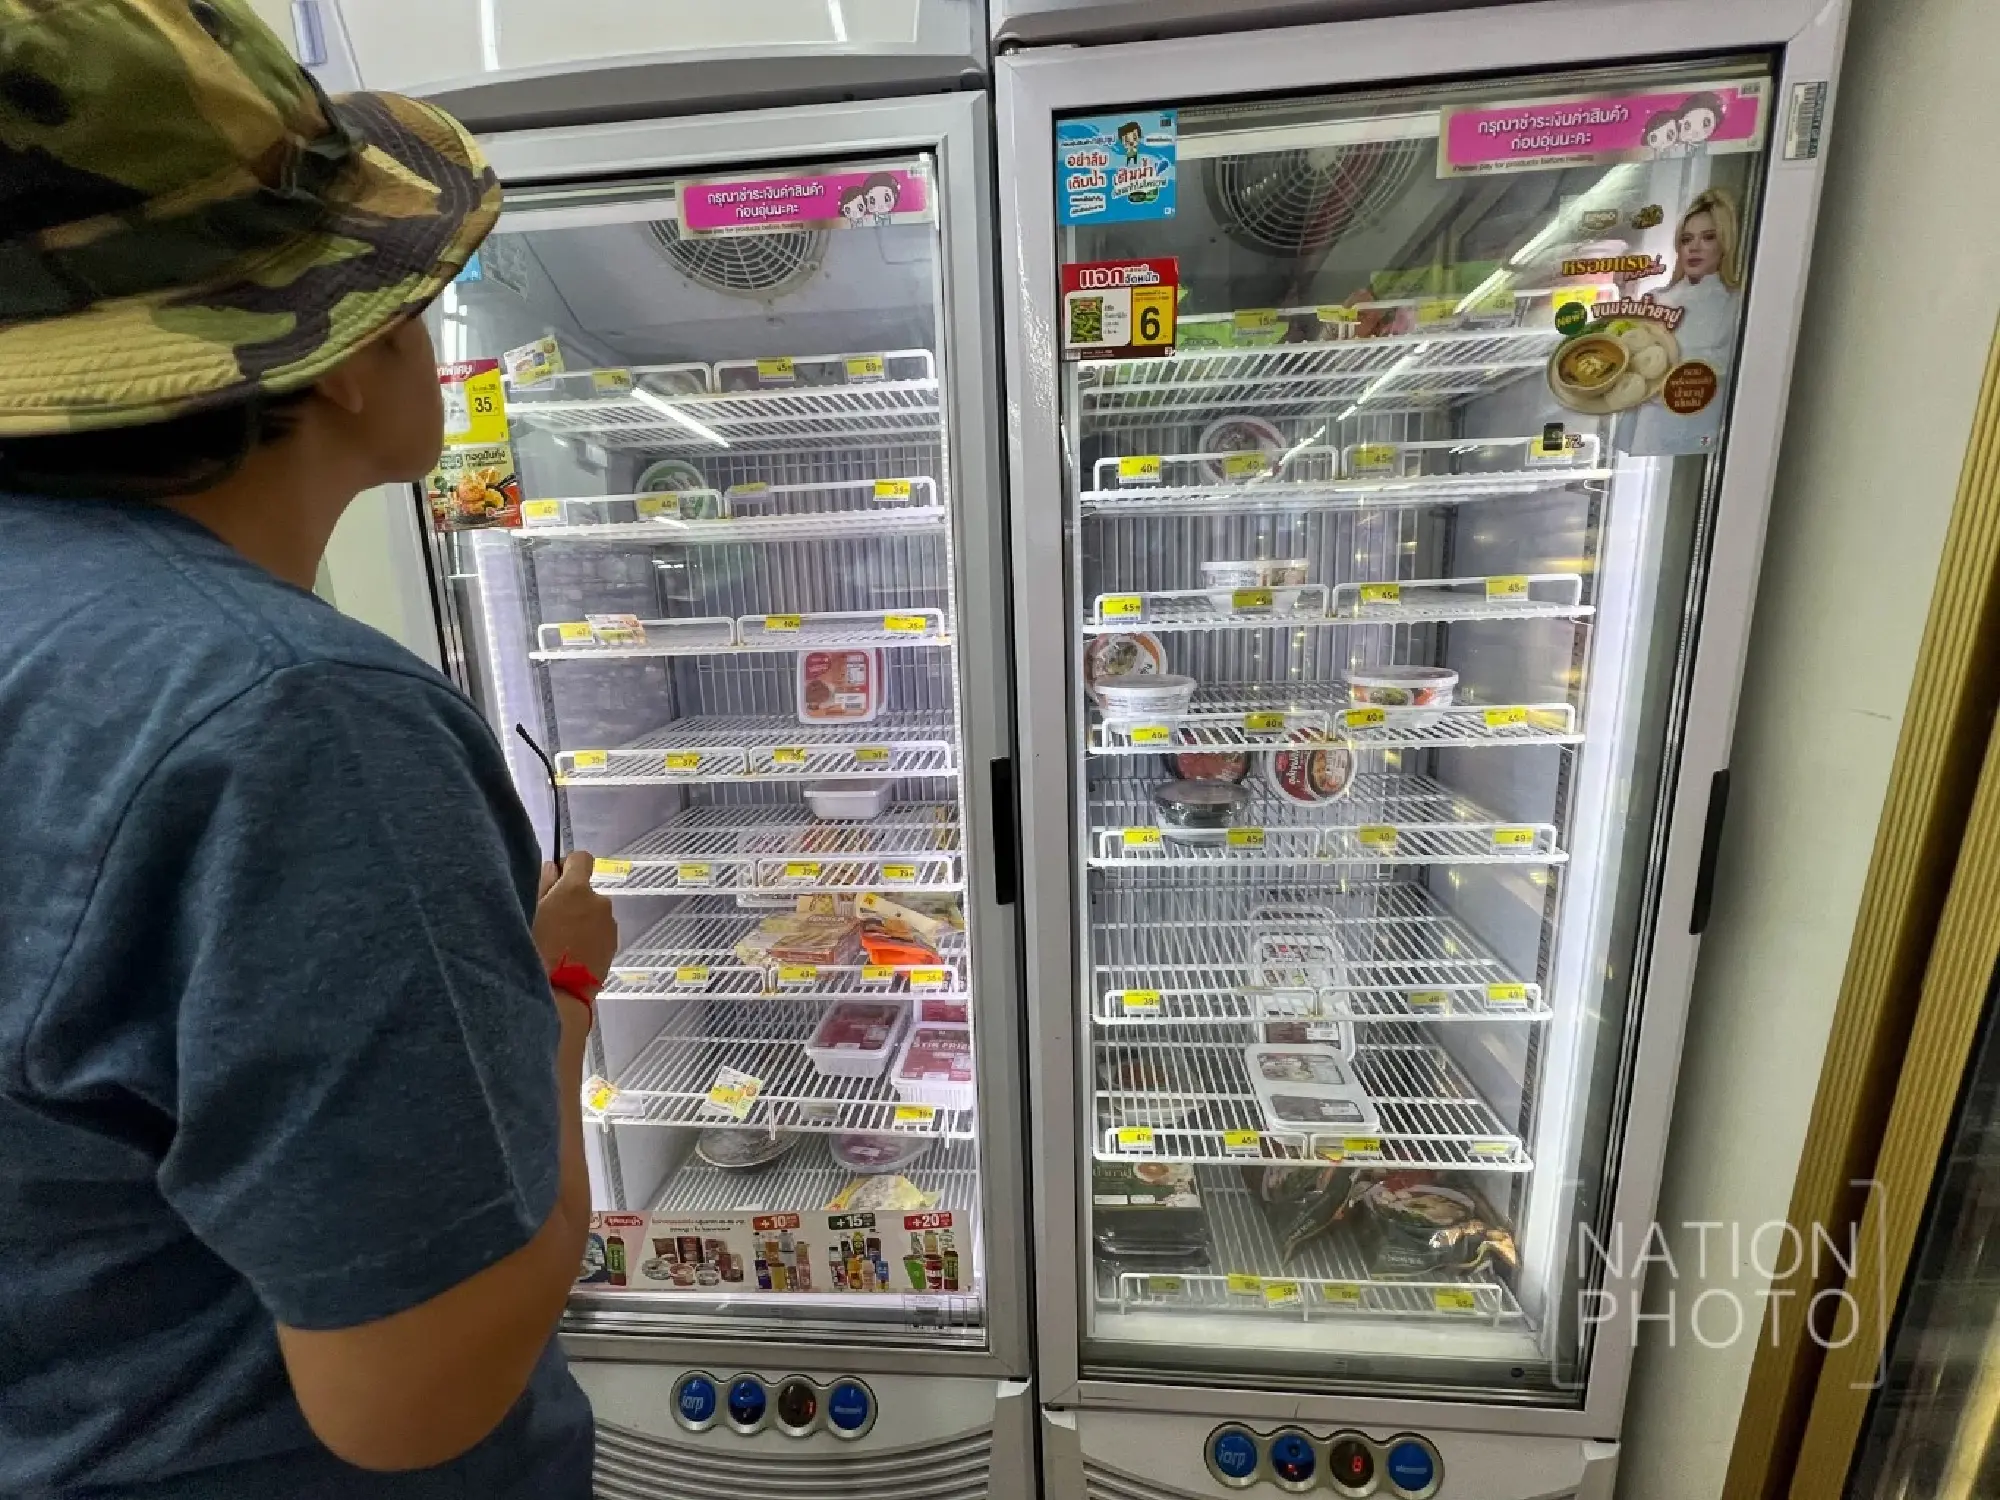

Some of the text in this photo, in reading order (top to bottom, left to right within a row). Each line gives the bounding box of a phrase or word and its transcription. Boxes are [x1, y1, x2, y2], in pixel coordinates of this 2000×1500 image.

[1478, 105, 1629, 136] กรุณาชำระเงินค่าสินค้า
[1511, 131, 1591, 152] ก่อนอุ่นนะคะ
[707, 182, 824, 207] กรุณาชำระเงินค่าสินค้า
[1141, 306, 1160, 341] 6
[474, 396, 493, 413] 35
[761, 1215, 786, 1229] +10
[836, 1214, 863, 1228] +15
[911, 1214, 939, 1228] +20
